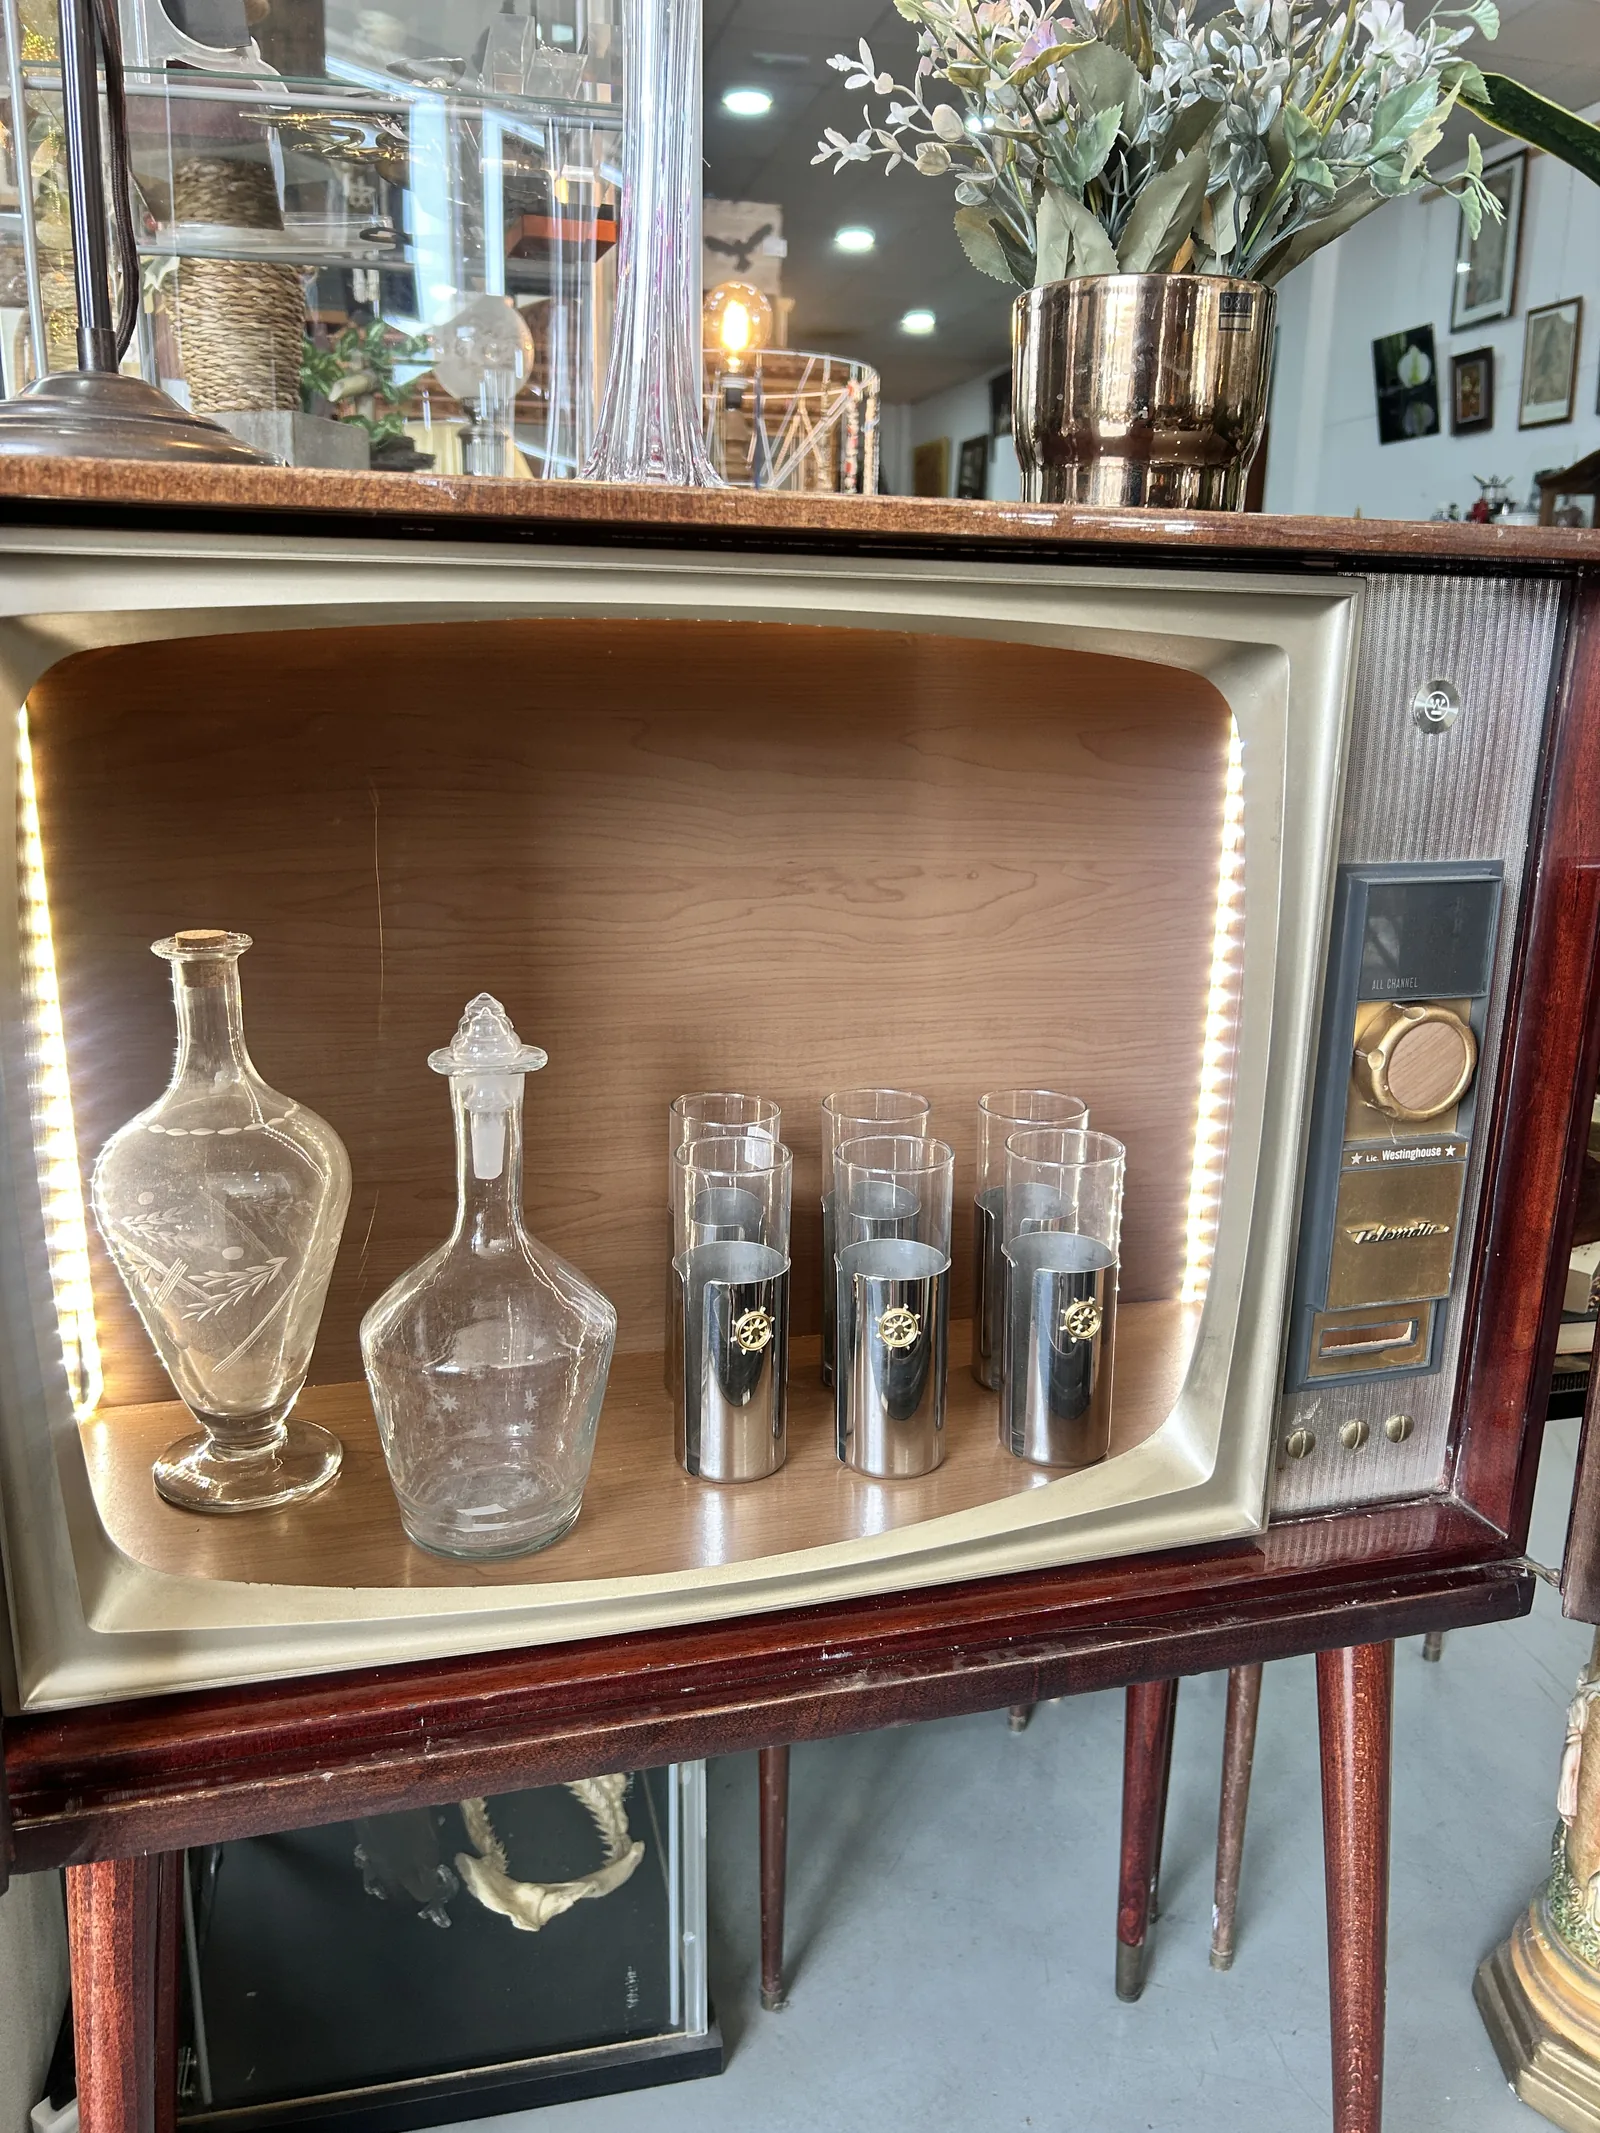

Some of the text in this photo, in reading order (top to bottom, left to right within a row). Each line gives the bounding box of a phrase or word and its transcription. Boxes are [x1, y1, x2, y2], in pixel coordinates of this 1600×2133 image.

[1371, 977, 1419, 990] ALL CHANNEL
[1365, 1146, 1442, 1163] Lic. Westinghouse
